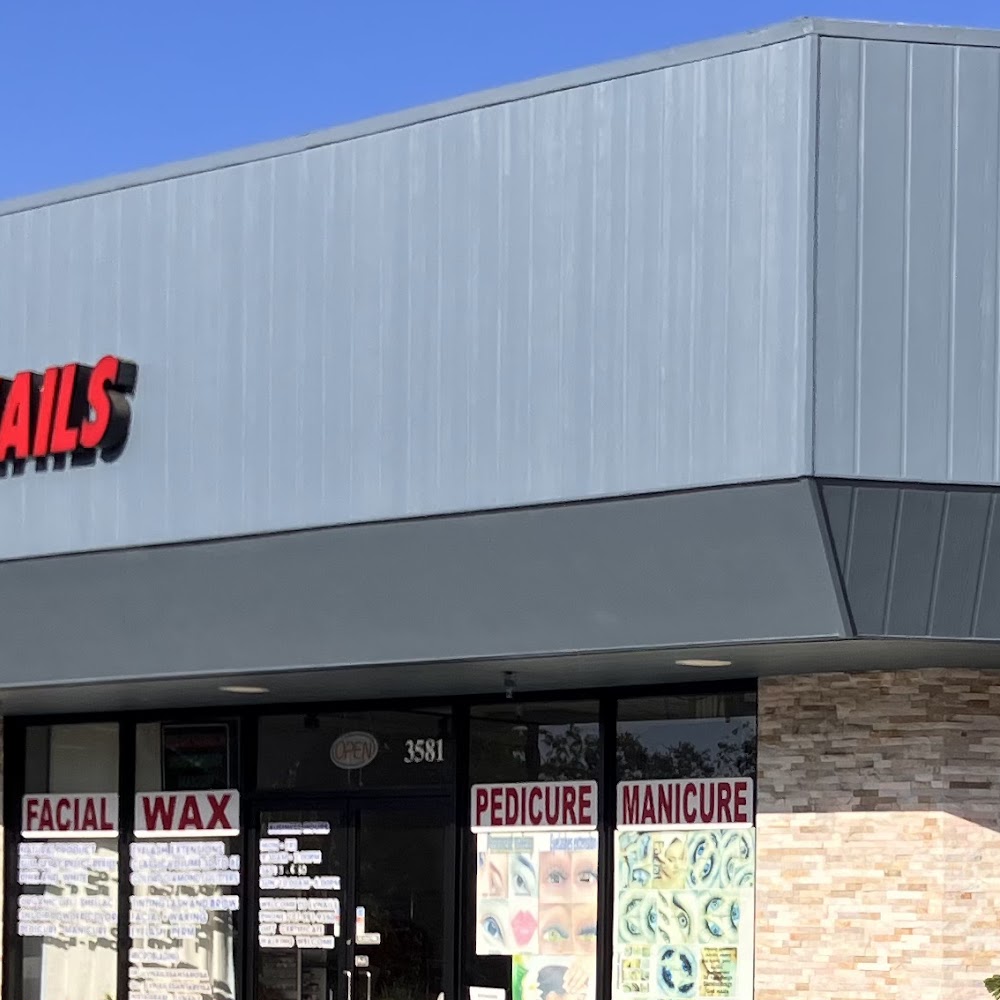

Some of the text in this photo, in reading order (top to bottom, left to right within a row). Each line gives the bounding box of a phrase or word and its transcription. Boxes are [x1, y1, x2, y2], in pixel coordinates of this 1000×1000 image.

[404, 738, 445, 763] 3581
[26, 797, 114, 831] FACIAL
[142, 793, 232, 830] WAX
[475, 786, 592, 826] PEDICURE
[622, 782, 748, 824] MANICURE
